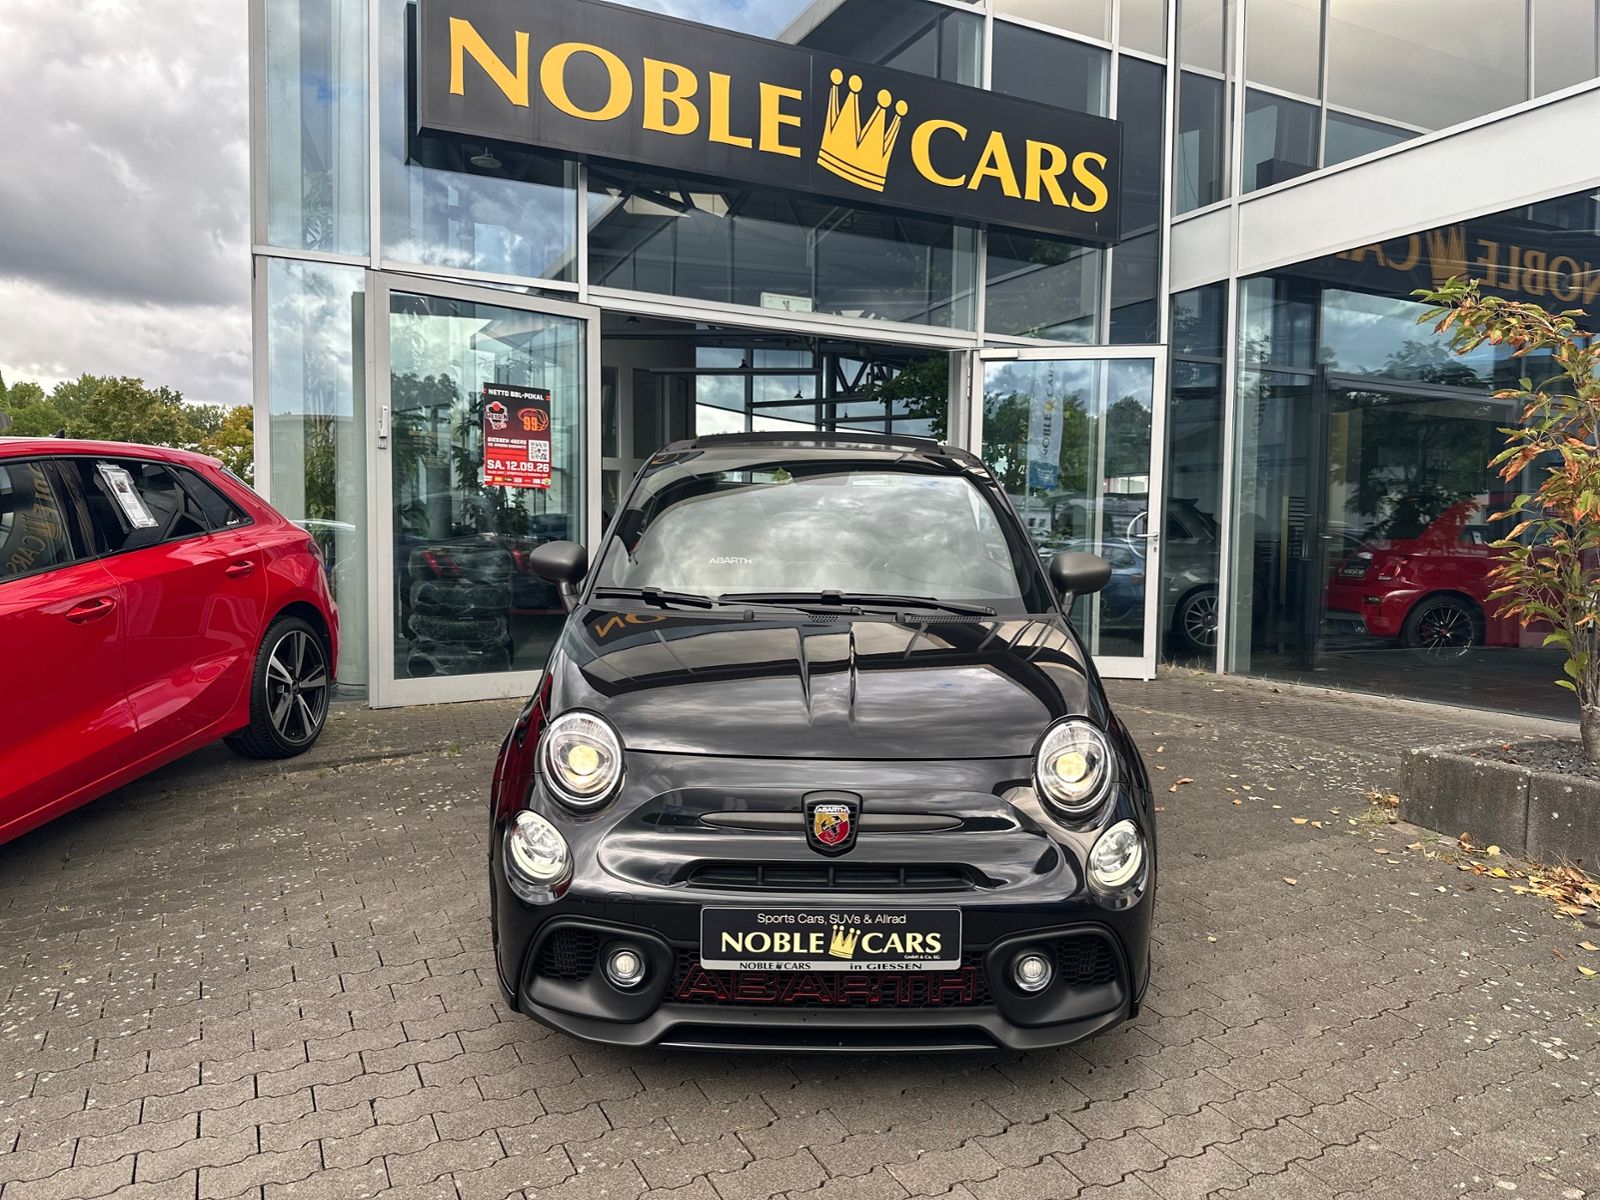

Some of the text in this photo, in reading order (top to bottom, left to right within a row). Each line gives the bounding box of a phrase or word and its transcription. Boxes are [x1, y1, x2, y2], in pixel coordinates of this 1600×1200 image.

[449, 16, 1109, 213] NOBLE CARS
[488, 388, 510, 397] NETTO
[709, 556, 752, 564] ABARTH
[757, 912, 907, 925] Sports Cars, SUVs & Allrad
[721, 931, 942, 954] NOBLE CARS
[739, 962, 812, 970] NOBLE CARS
[676, 963, 976, 1002] ABARTH
